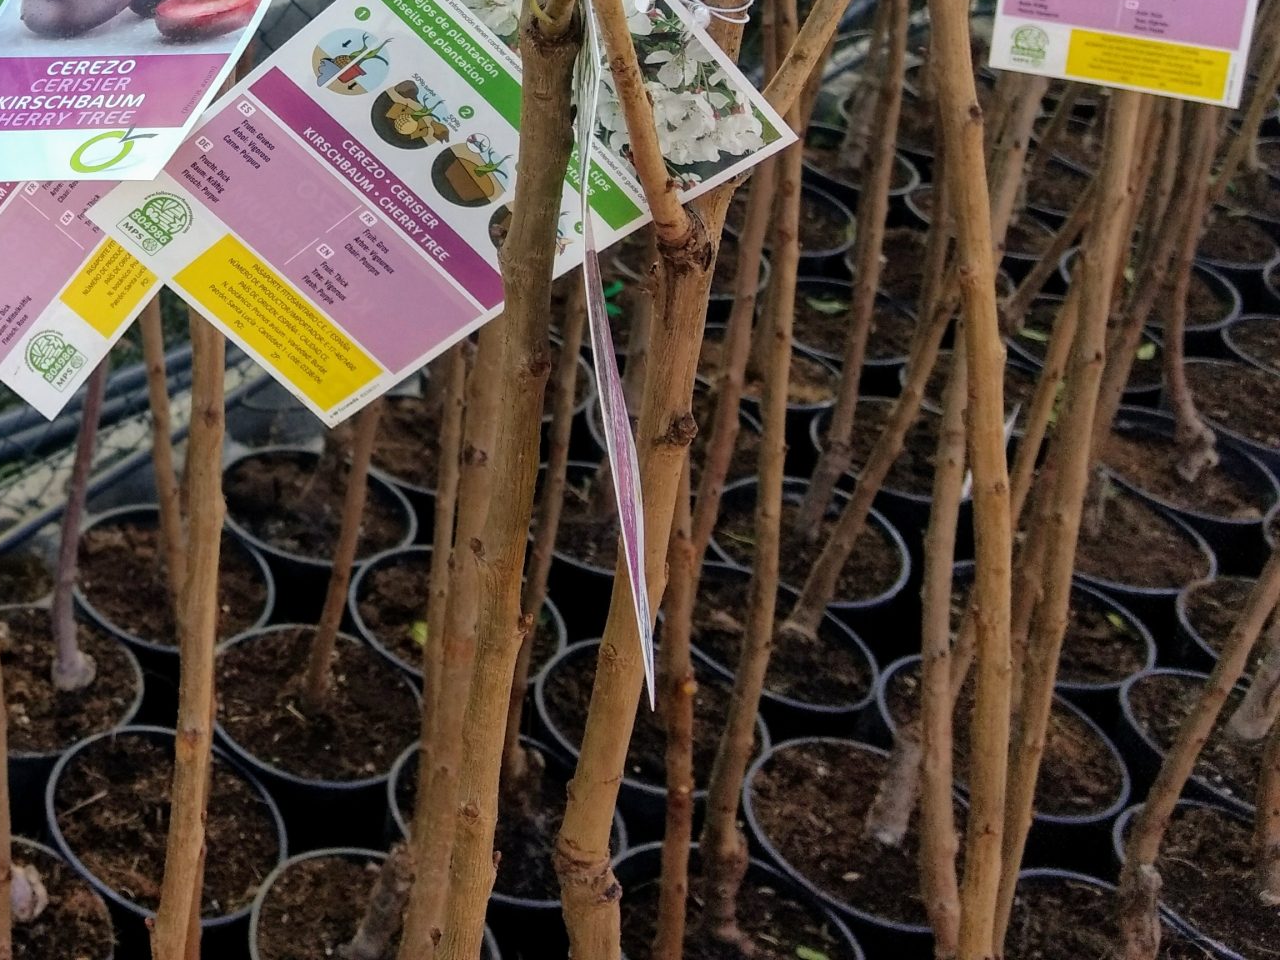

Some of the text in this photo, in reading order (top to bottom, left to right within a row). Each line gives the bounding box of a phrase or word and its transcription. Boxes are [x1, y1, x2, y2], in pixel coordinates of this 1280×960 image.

[420, 23, 439, 39] de
[432, 35, 488, 86] plantation
[433, 13, 452, 30] de
[445, 26, 502, 79] plantación
[43, 59, 138, 75] CEREZO
[410, 72, 427, 87] 50%
[27, 76, 133, 93] CERISIER
[73, 110, 136, 125] TREE
[239, 102, 252, 114] ES
[445, 113, 462, 128] 50%
[197, 138, 211, 149] DE
[221, 133, 243, 152] Carne:
[231, 125, 272, 163] Árbol: Vigoroso
[240, 119, 276, 151] Fruto: Grueso
[189, 161, 226, 193] Baum: Kräftig
[198, 153, 232, 182] Frucht: Dick
[588, 169, 613, 192] tips
[26, 182, 37, 193] FR
[180, 168, 221, 204] Fleisch: Purpur
[302, 126, 450, 261] KIRSCHBAUM CHERRY TREE
[339, 138, 440, 229] CEREZO CERISIER
[623, 178, 641, 194] guide
[61, 212, 72, 223] EN
[122, 221, 144, 240] MPS
[129, 209, 170, 244] 804986
[361, 213, 374, 224] FR
[318, 245, 331, 256] EN
[352, 235, 396, 274] Arbre: Vigoureux
[361, 228, 391, 254] Fruit: Gros
[227, 257, 254, 280] NÚMERO
[250, 276, 261, 286] DE
[342, 242, 381, 277] Chair: Pourpre
[309, 268, 348, 301] Tree: Vigorous
[319, 261, 350, 288] Fruit: Thick
[249, 290, 260, 299] DE
[300, 274, 336, 305] Flesh: Purple
[5, 294, 32, 324] Mittelkräftig
[1, 313, 29, 345] Fleisch: Rose
[43, 346, 75, 381] 804986
[55, 367, 73, 386] MPS
